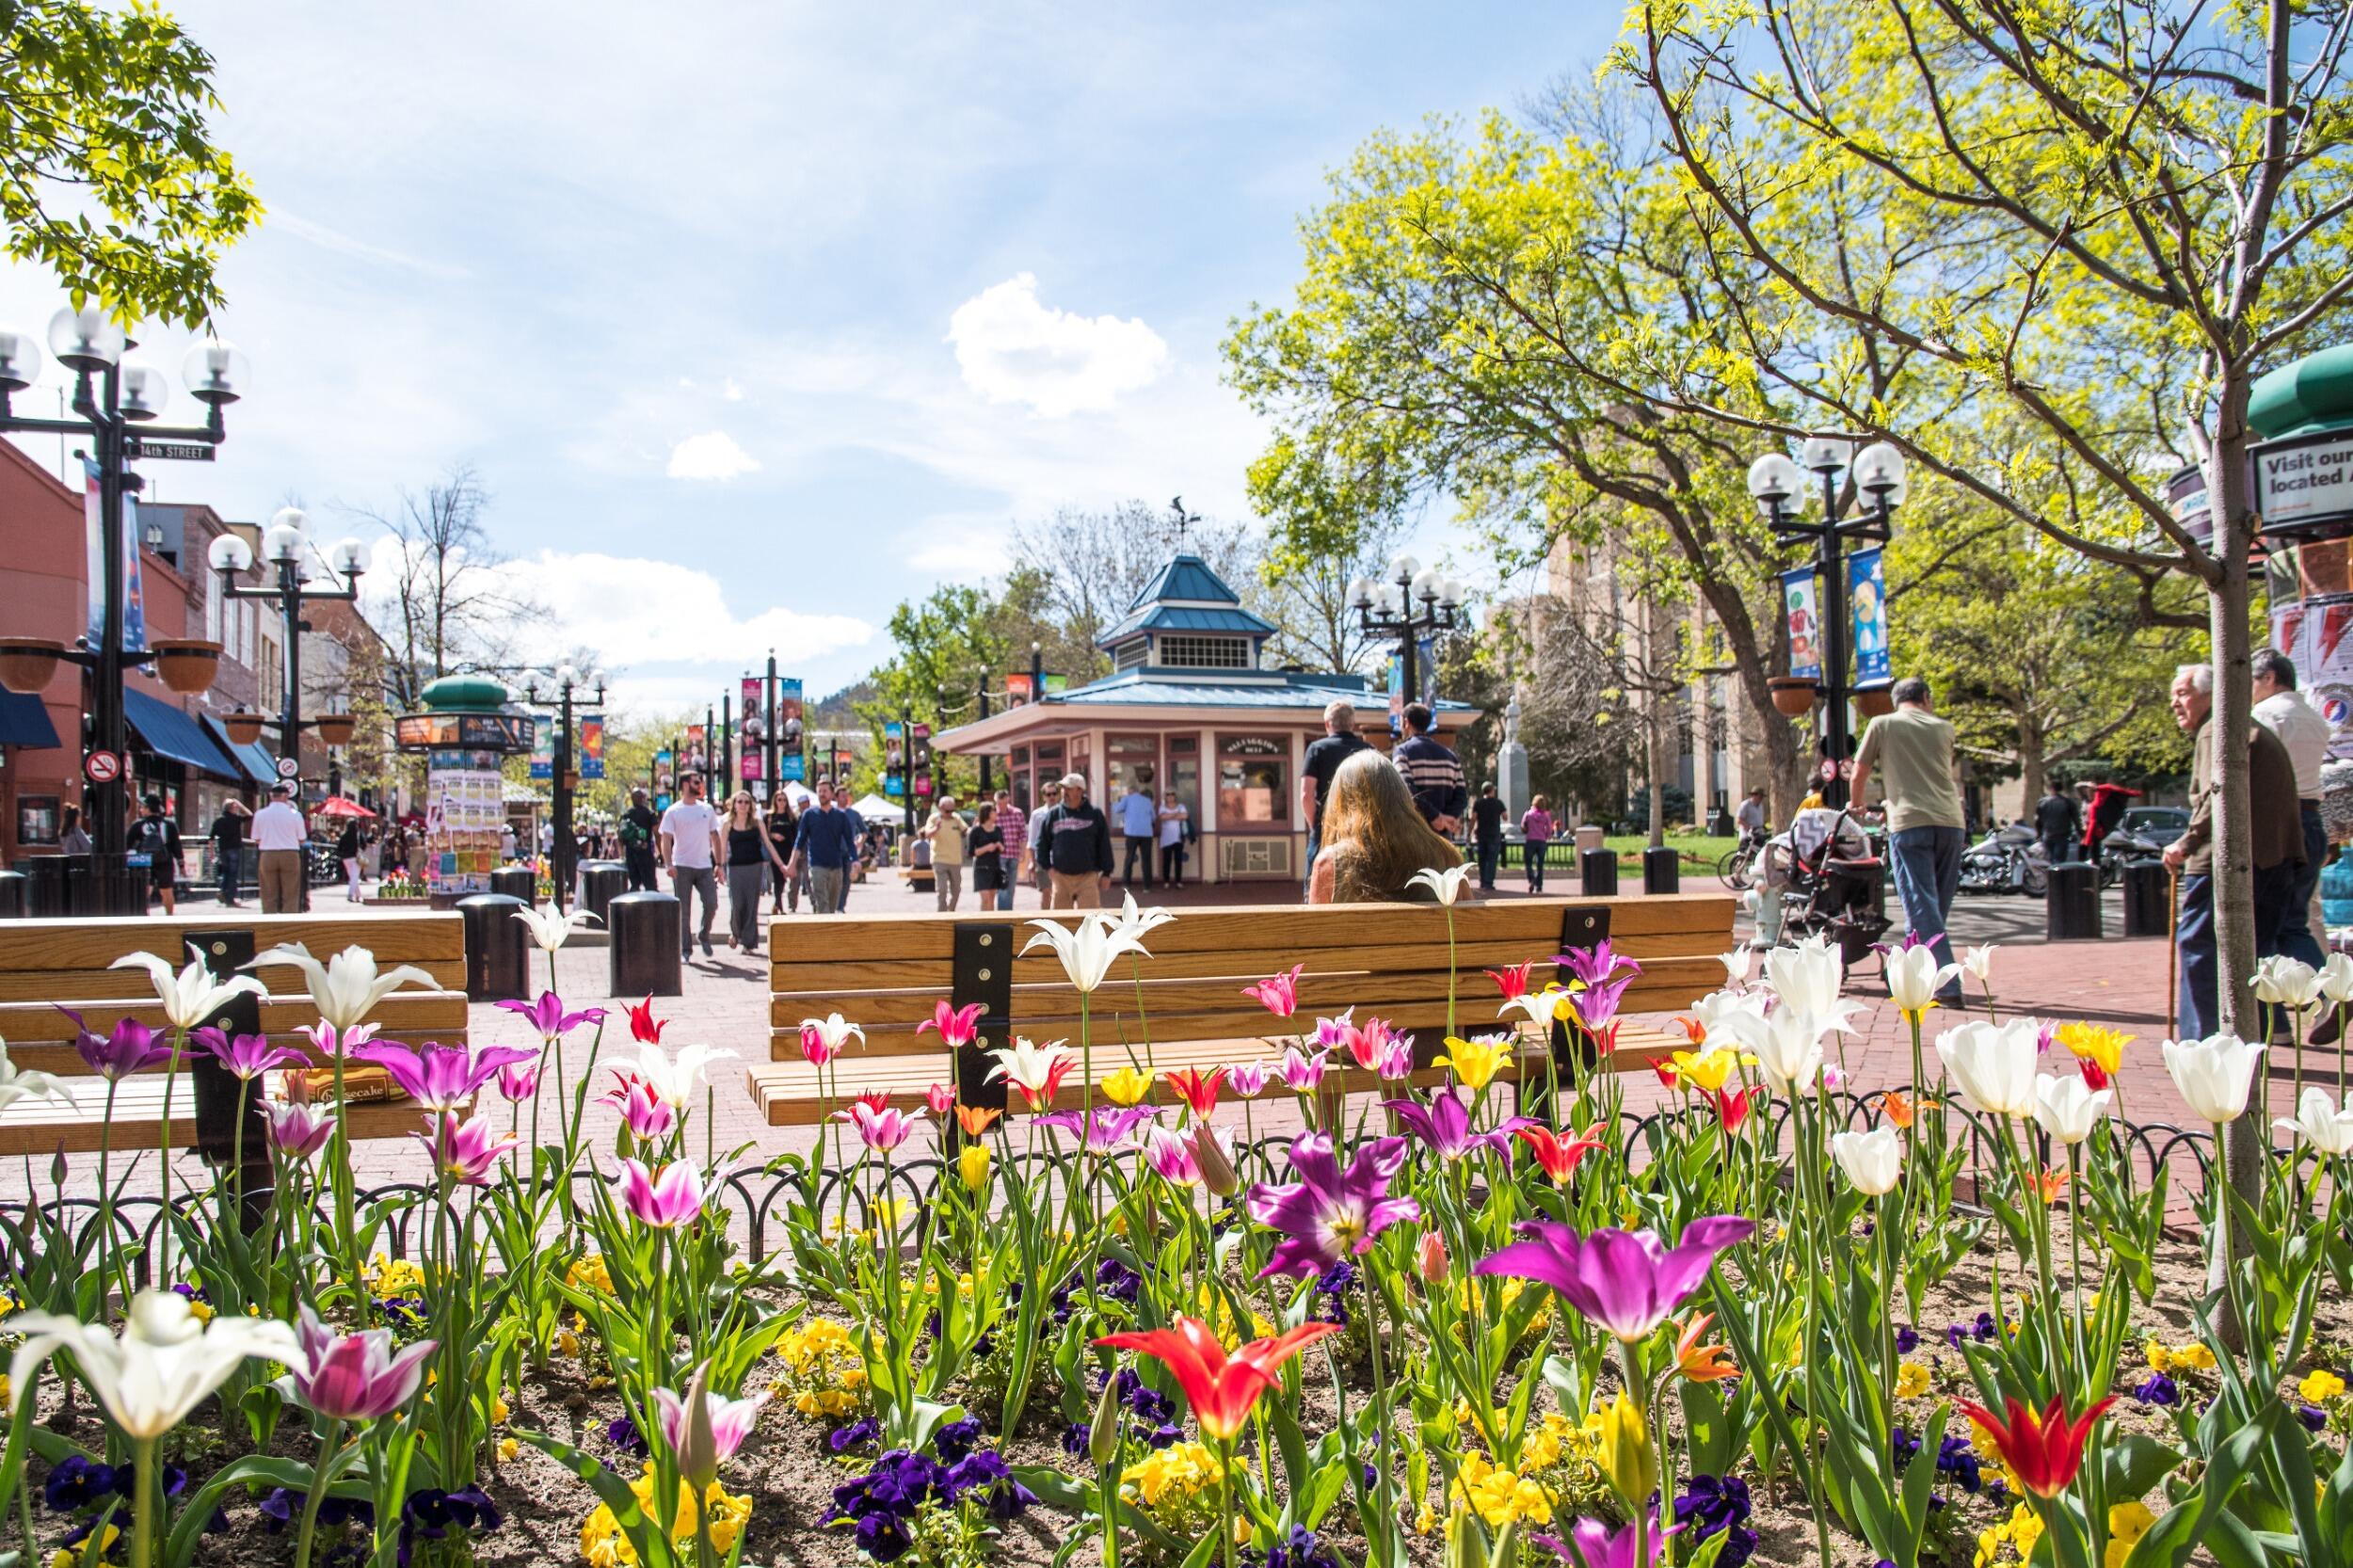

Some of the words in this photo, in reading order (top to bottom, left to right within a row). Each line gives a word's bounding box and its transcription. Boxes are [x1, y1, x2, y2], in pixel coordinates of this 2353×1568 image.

[140, 445, 163, 456] 14th
[167, 446, 203, 458] STREET
[2266, 453, 2313, 474] Visit
[2319, 449, 2353, 466] our
[2270, 467, 2343, 495] located
